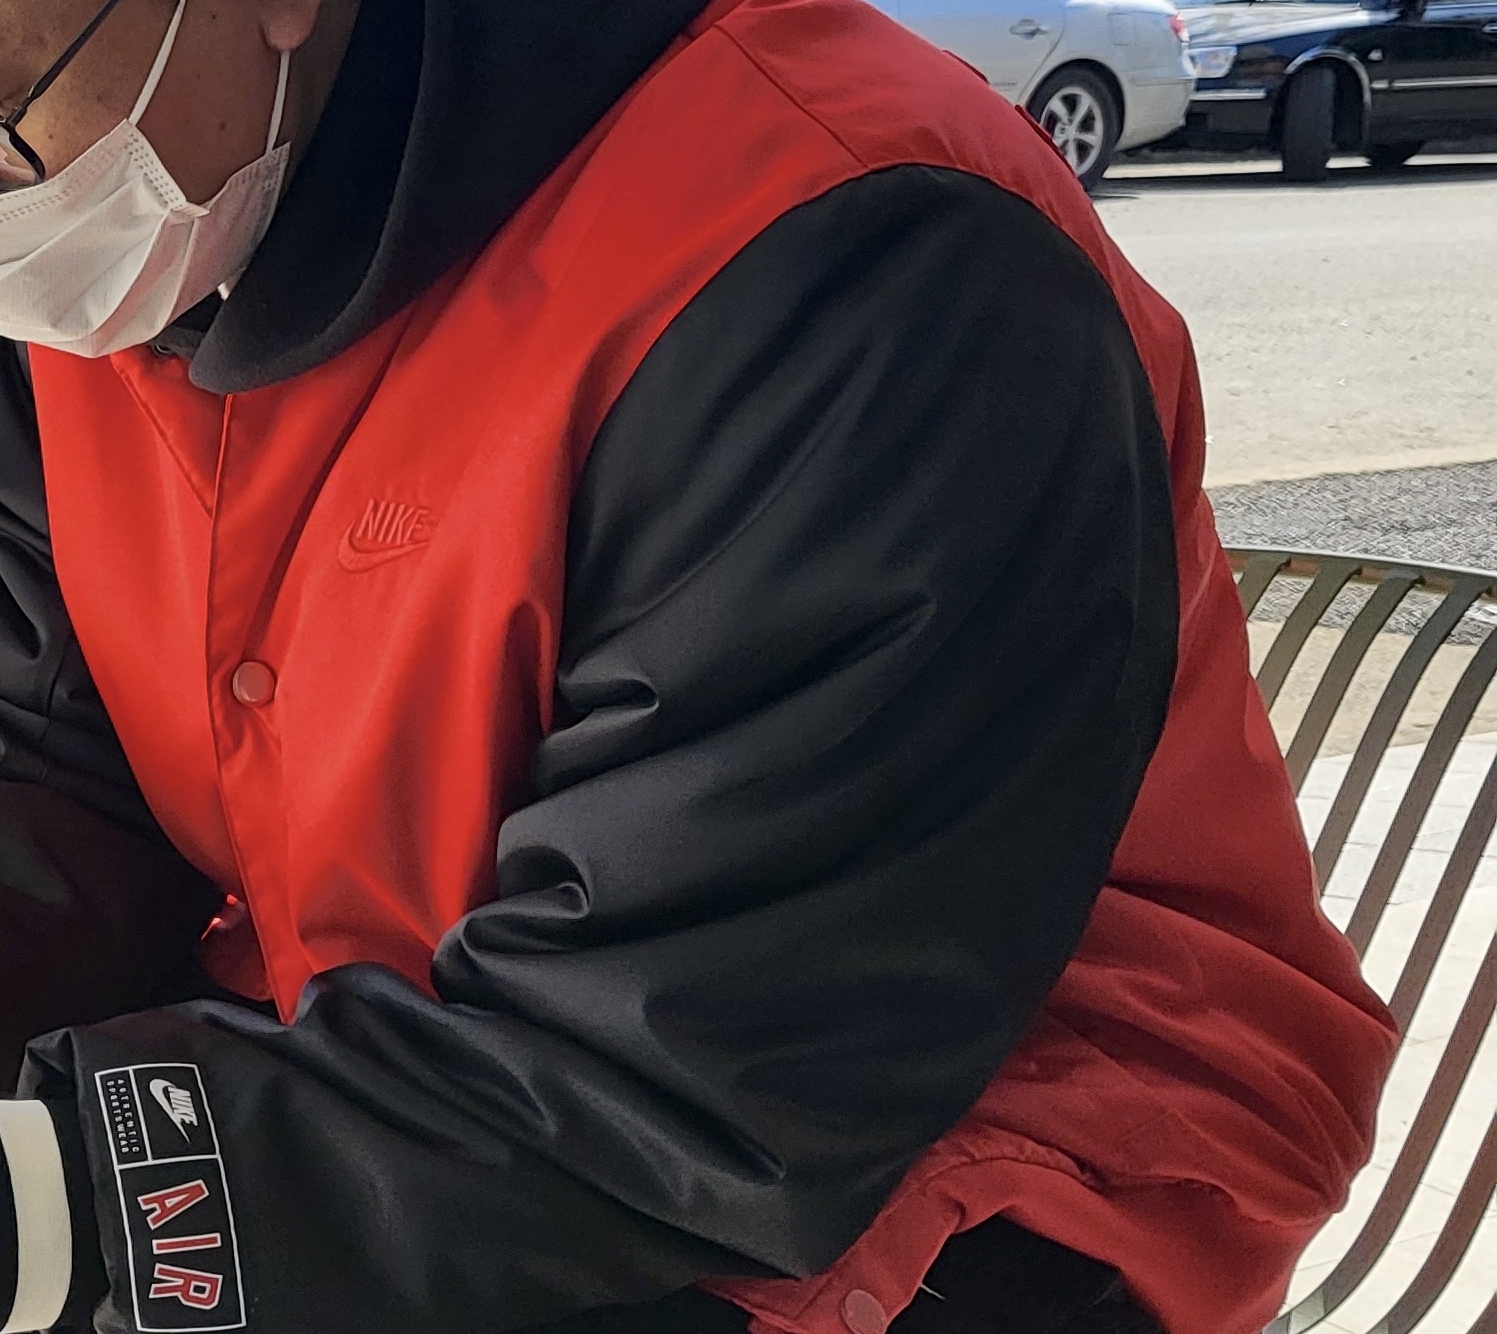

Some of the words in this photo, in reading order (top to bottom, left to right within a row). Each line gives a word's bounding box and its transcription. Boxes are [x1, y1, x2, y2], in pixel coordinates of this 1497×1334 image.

[355, 498, 431, 545] NIKE
[106, 1080, 130, 1154] SPORTSWEAR
[117, 1078, 141, 1153] AUTHENTIC
[167, 1085, 199, 1127] NIKE
[137, 1179, 224, 1310] AIR
